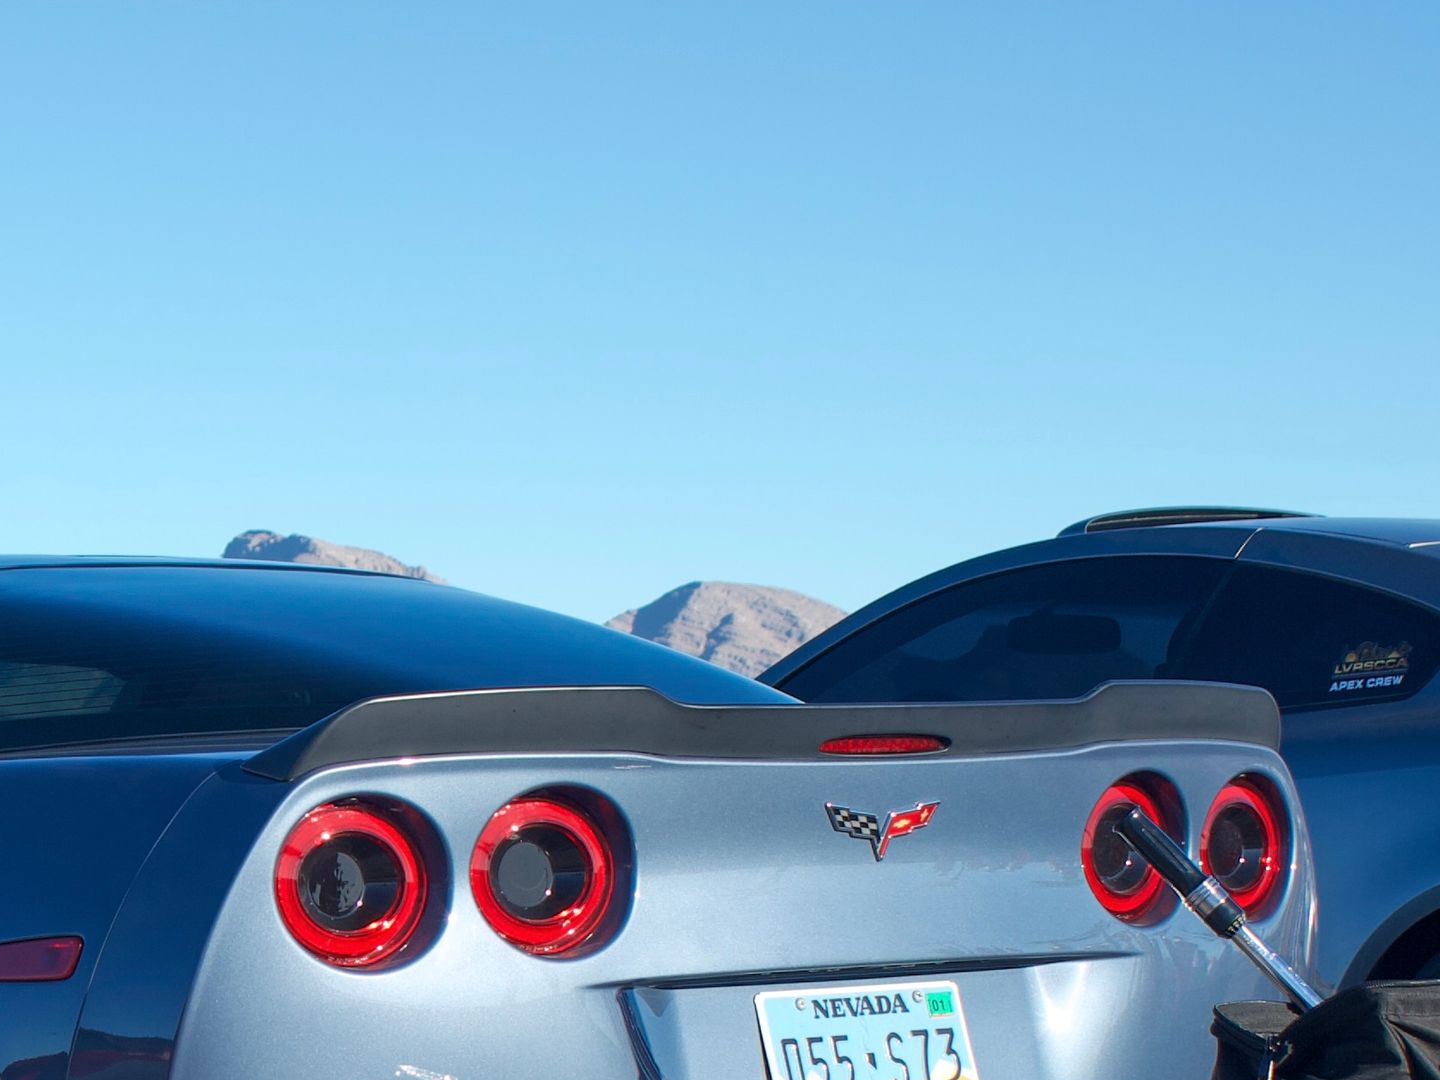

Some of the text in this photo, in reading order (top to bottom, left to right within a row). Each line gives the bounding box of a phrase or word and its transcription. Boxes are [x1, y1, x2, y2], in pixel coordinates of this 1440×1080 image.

[1329, 675, 1404, 692] APEX CREW
[812, 993, 909, 1019] NEVADA
[931, 999, 947, 1012] 01
